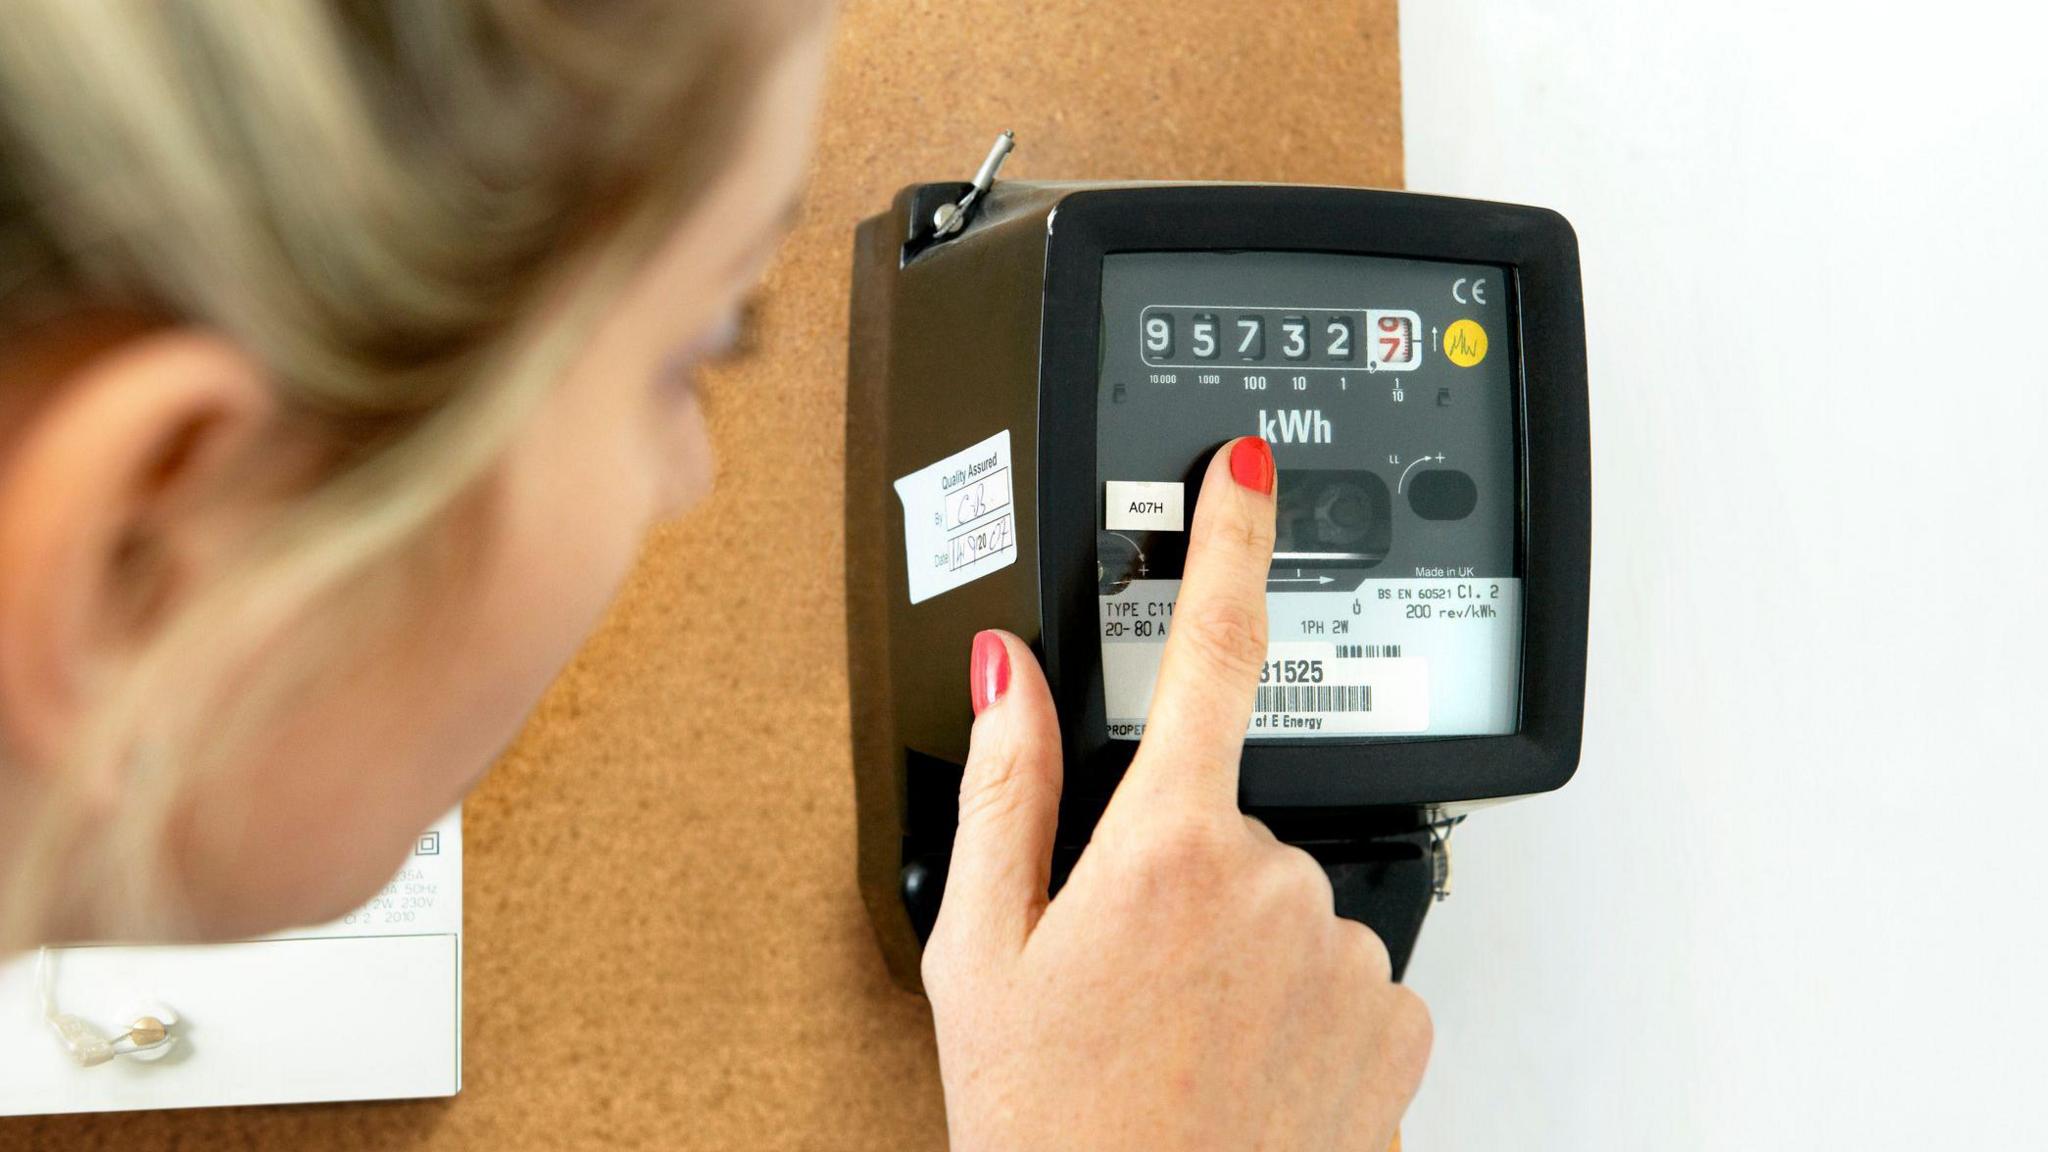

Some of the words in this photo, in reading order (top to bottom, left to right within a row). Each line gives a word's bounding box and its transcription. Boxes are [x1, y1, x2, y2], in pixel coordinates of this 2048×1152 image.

[1452, 278, 1486, 305] CE
[1243, 376, 1267, 390] 100
[1292, 376, 1307, 390] 10
[1340, 377, 1346, 390] 1
[1259, 409, 1331, 443] kWh
[942, 468, 966, 490] Quality
[967, 451, 998, 478] Assured
[1128, 501, 1164, 514] A07H
[934, 552, 949, 568] Date
[1415, 566, 1444, 578] Made
[1446, 566, 1456, 577] in
[1459, 566, 1475, 578] UK
[1378, 588, 1392, 600] BS
[1398, 588, 1412, 600] EN
[1418, 588, 1452, 600] 60521
[1490, 584, 1500, 599] 2
[1106, 602, 1139, 617] TYPE
[1148, 602, 1176, 617] C11
[1406, 604, 1432, 619] 200
[1440, 604, 1497, 619] rev/kWh
[1158, 622, 1166, 636] A
[1301, 620, 1325, 634] 1PH
[1332, 620, 1349, 634] 2W
[1255, 715, 1268, 728] of
[1272, 714, 1279, 728] E
[1283, 714, 1323, 730] Energy
[385, 910, 416, 923] 2010
